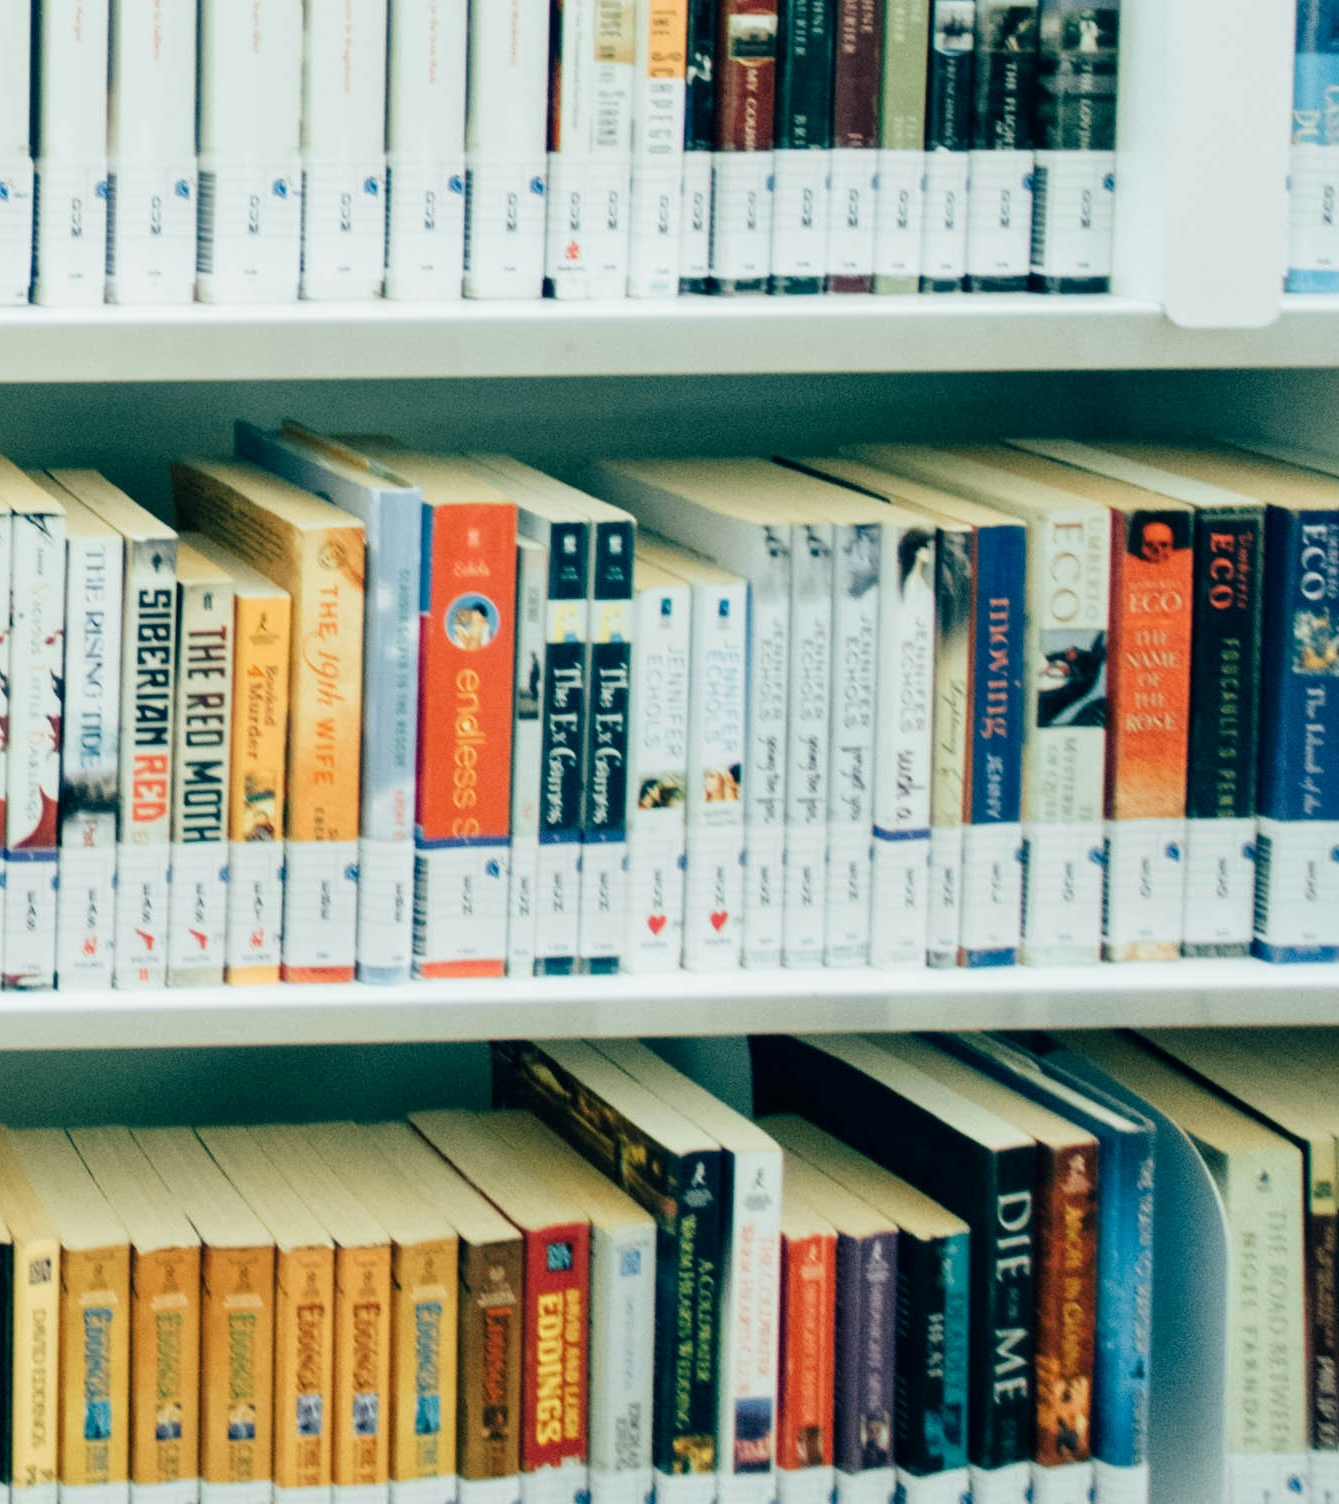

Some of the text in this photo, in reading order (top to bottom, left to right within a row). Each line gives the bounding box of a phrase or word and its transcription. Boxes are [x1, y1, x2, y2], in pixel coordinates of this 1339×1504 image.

[131, 588, 172, 823] SIBERIAN RED
[981, 596, 1010, 740] moving
[1128, 592, 1184, 613] ECO
[183, 630, 228, 844] THE RED MOTH
[993, 1189, 1033, 1403] DIE ME
